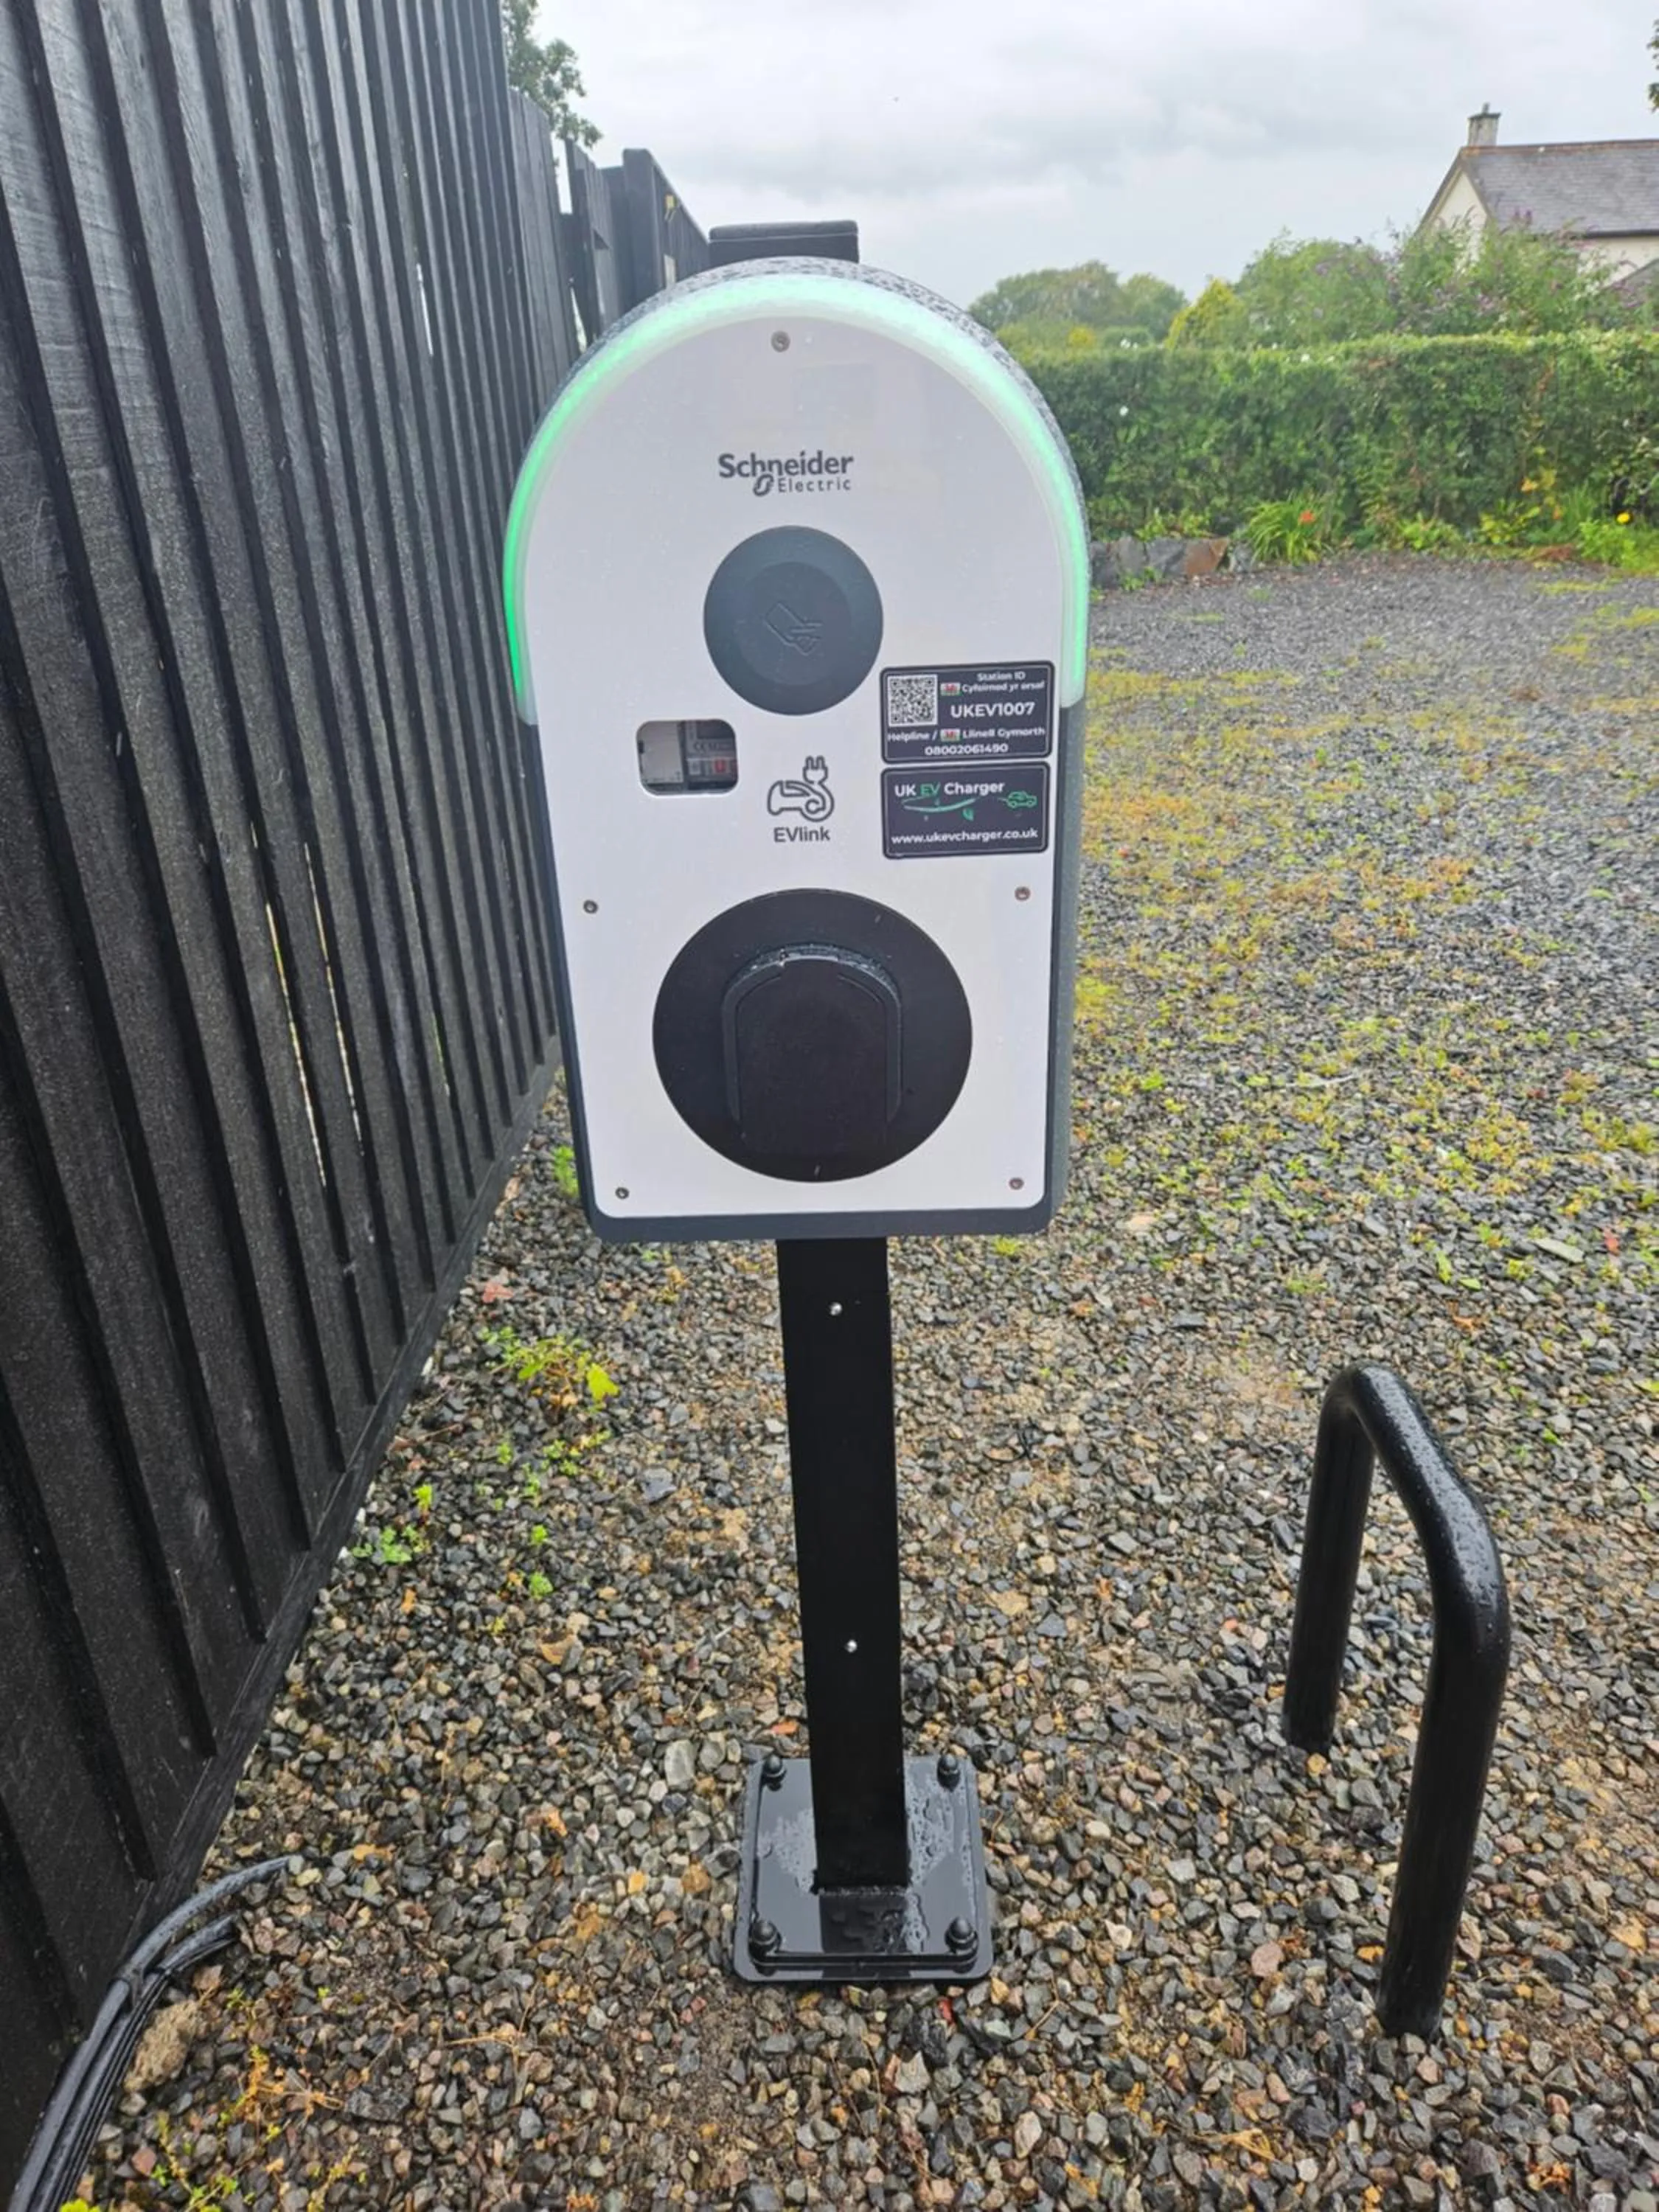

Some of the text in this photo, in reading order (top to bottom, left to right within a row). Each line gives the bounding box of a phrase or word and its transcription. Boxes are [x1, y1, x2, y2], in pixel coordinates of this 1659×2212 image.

[718, 449, 854, 478] Schneider
[778, 477, 851, 493] Electric
[977, 671, 1026, 681] Station ID
[950, 702, 1035, 717] UKEV1007
[887, 731, 929, 743] Helpline
[924, 742, 1009, 756] 08002061490
[894, 781, 1006, 797] UK EV Charger
[773, 826, 831, 843] EVlink
[891, 827, 1039, 845] www.ukevcharger.co.uk
